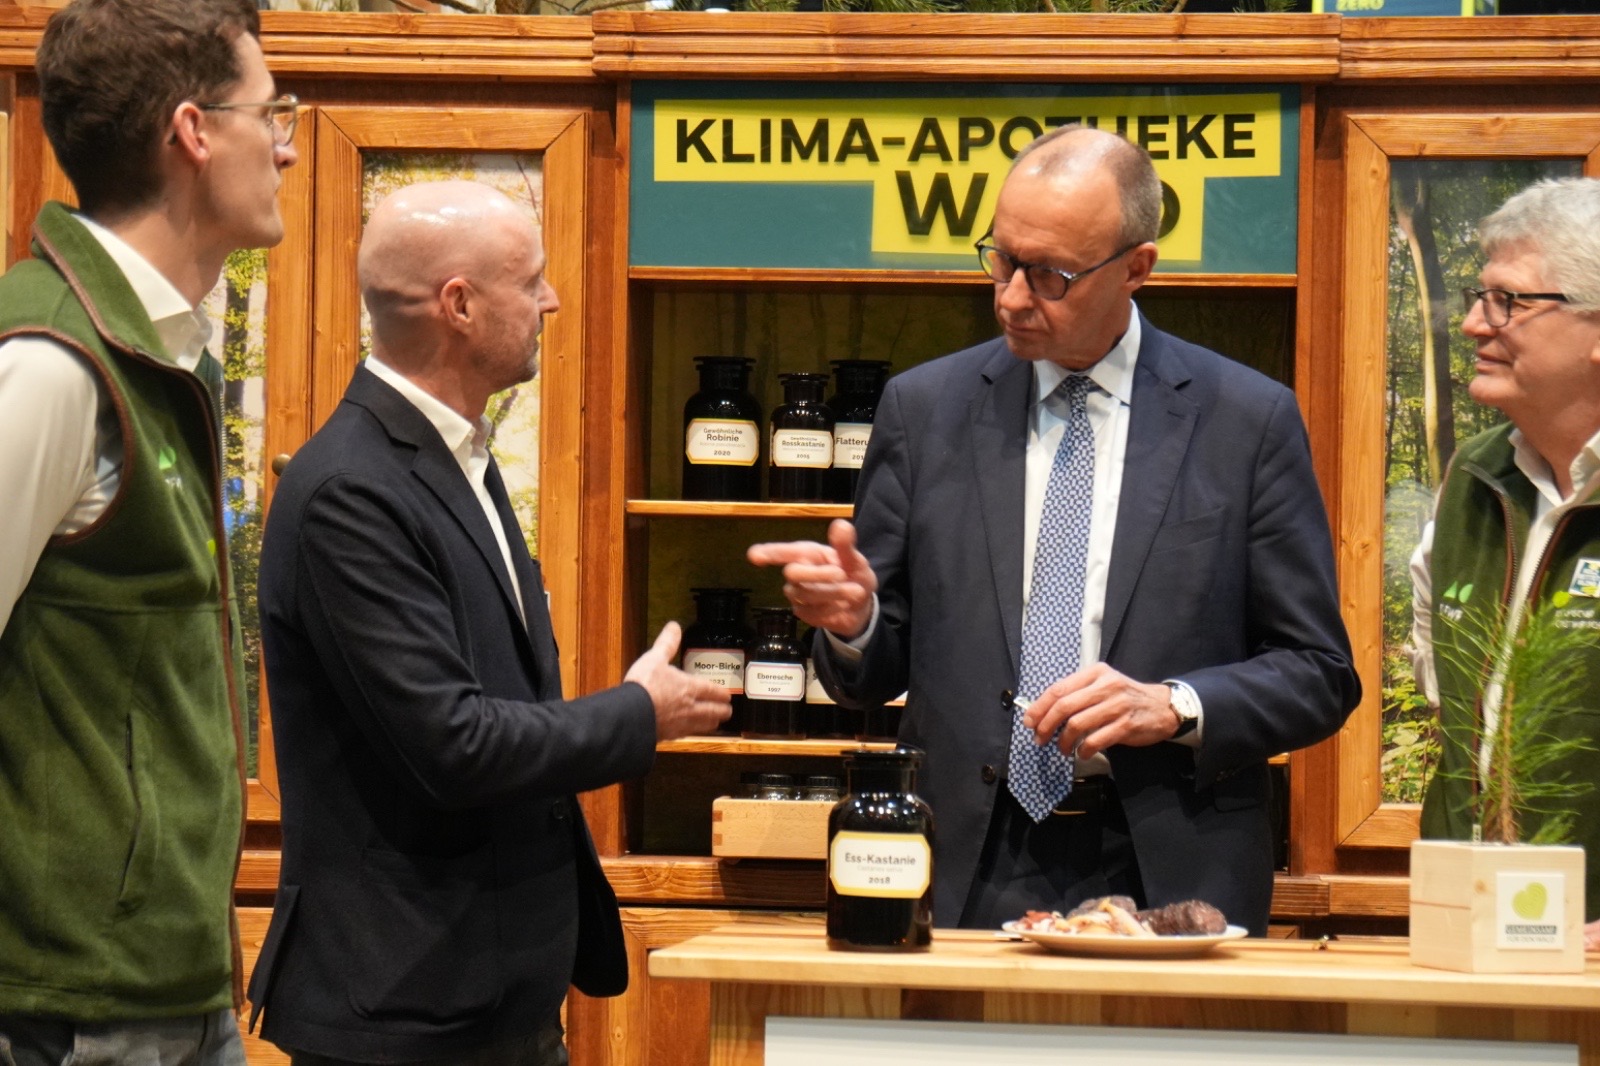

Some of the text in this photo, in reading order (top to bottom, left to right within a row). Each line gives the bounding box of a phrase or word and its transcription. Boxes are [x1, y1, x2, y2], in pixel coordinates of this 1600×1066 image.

[676, 114, 1256, 163] KLIMA-APOEKE
[706, 433, 740, 442] Robinie
[782, 440, 826, 448] Rosskastanie
[694, 662, 741, 671] Moor-Birke
[757, 673, 794, 681] Eberesche
[845, 852, 916, 865] Ess-Kastanie
[868, 876, 891, 884] 2018
